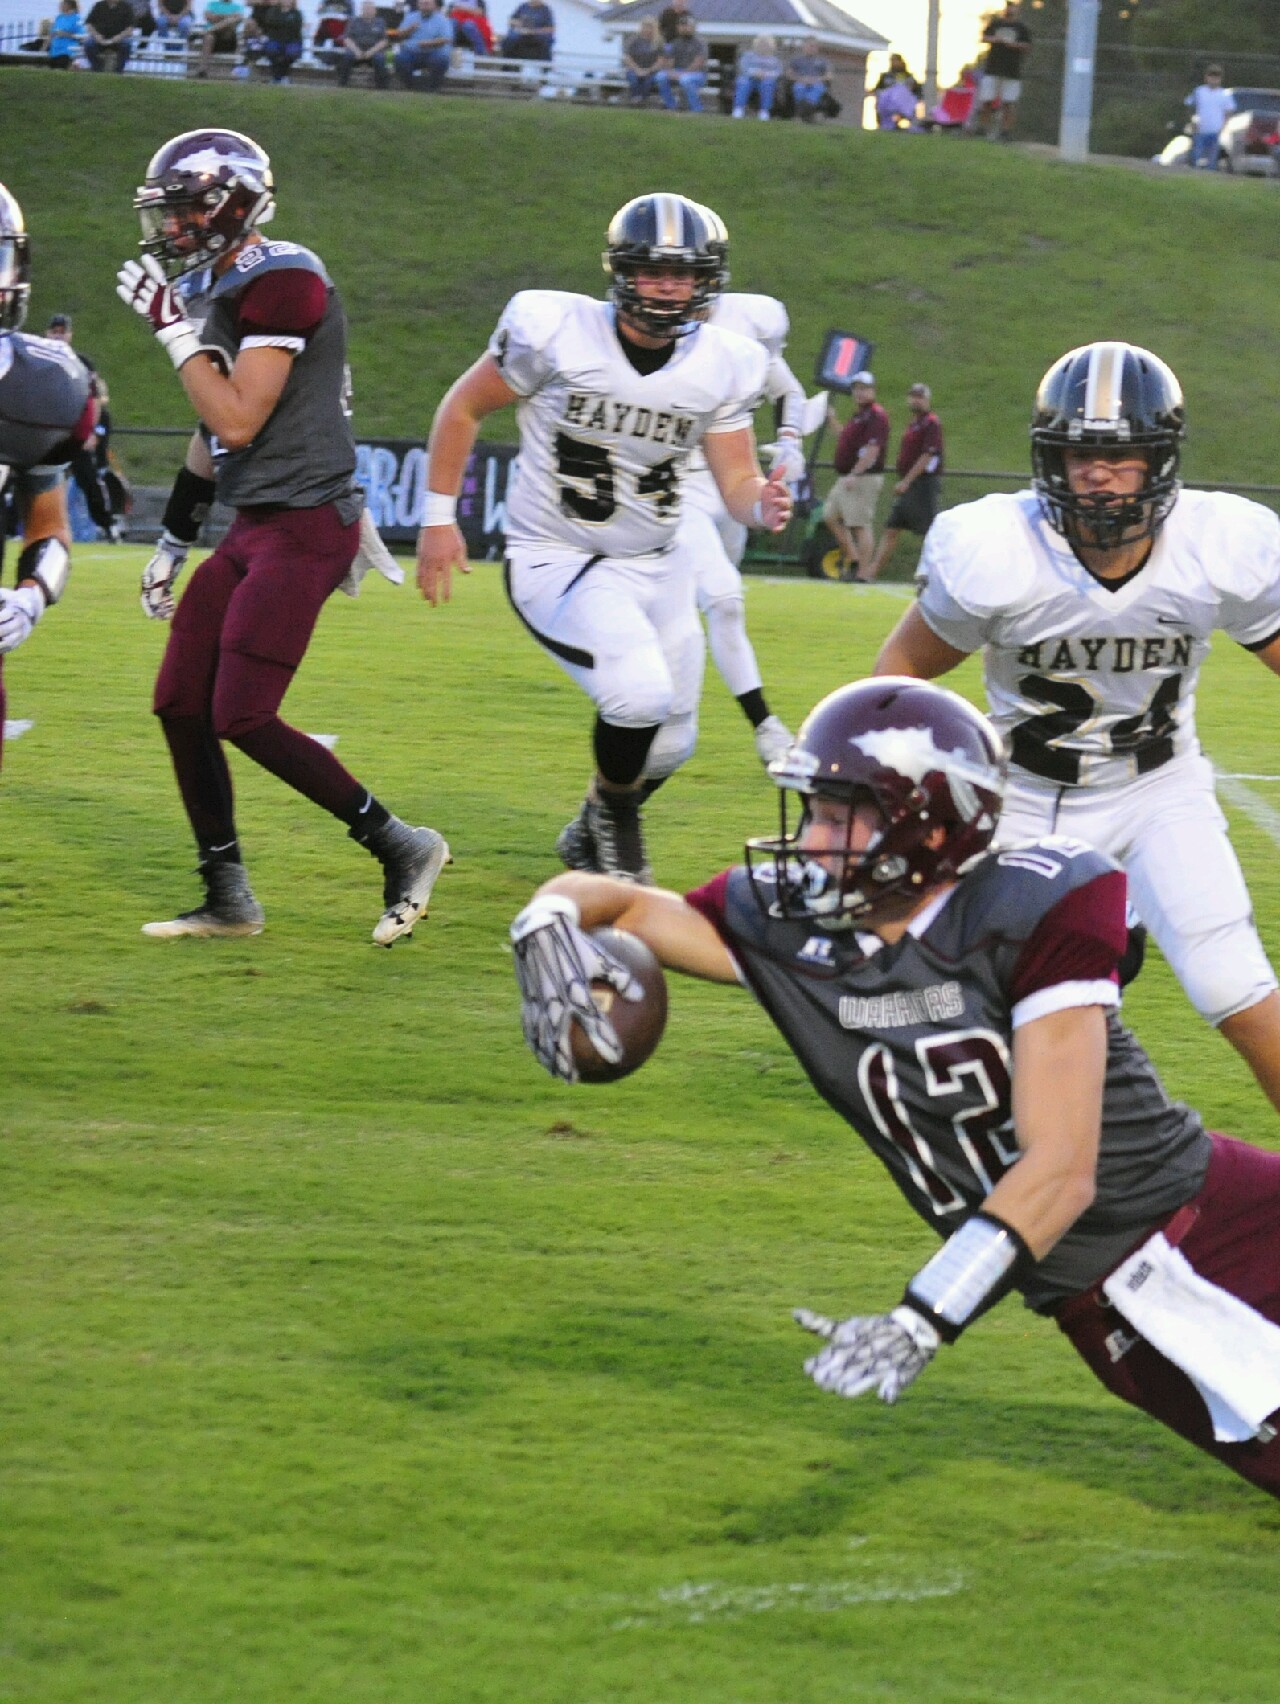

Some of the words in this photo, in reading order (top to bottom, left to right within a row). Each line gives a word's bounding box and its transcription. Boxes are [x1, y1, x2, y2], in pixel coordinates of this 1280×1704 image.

[566, 393, 695, 446] HAYDEN
[553, 430, 682, 529] 54
[1017, 634, 1194, 673] HAYDEN
[1008, 672, 1182, 788] 24
[857, 1027, 1022, 1216] 12
